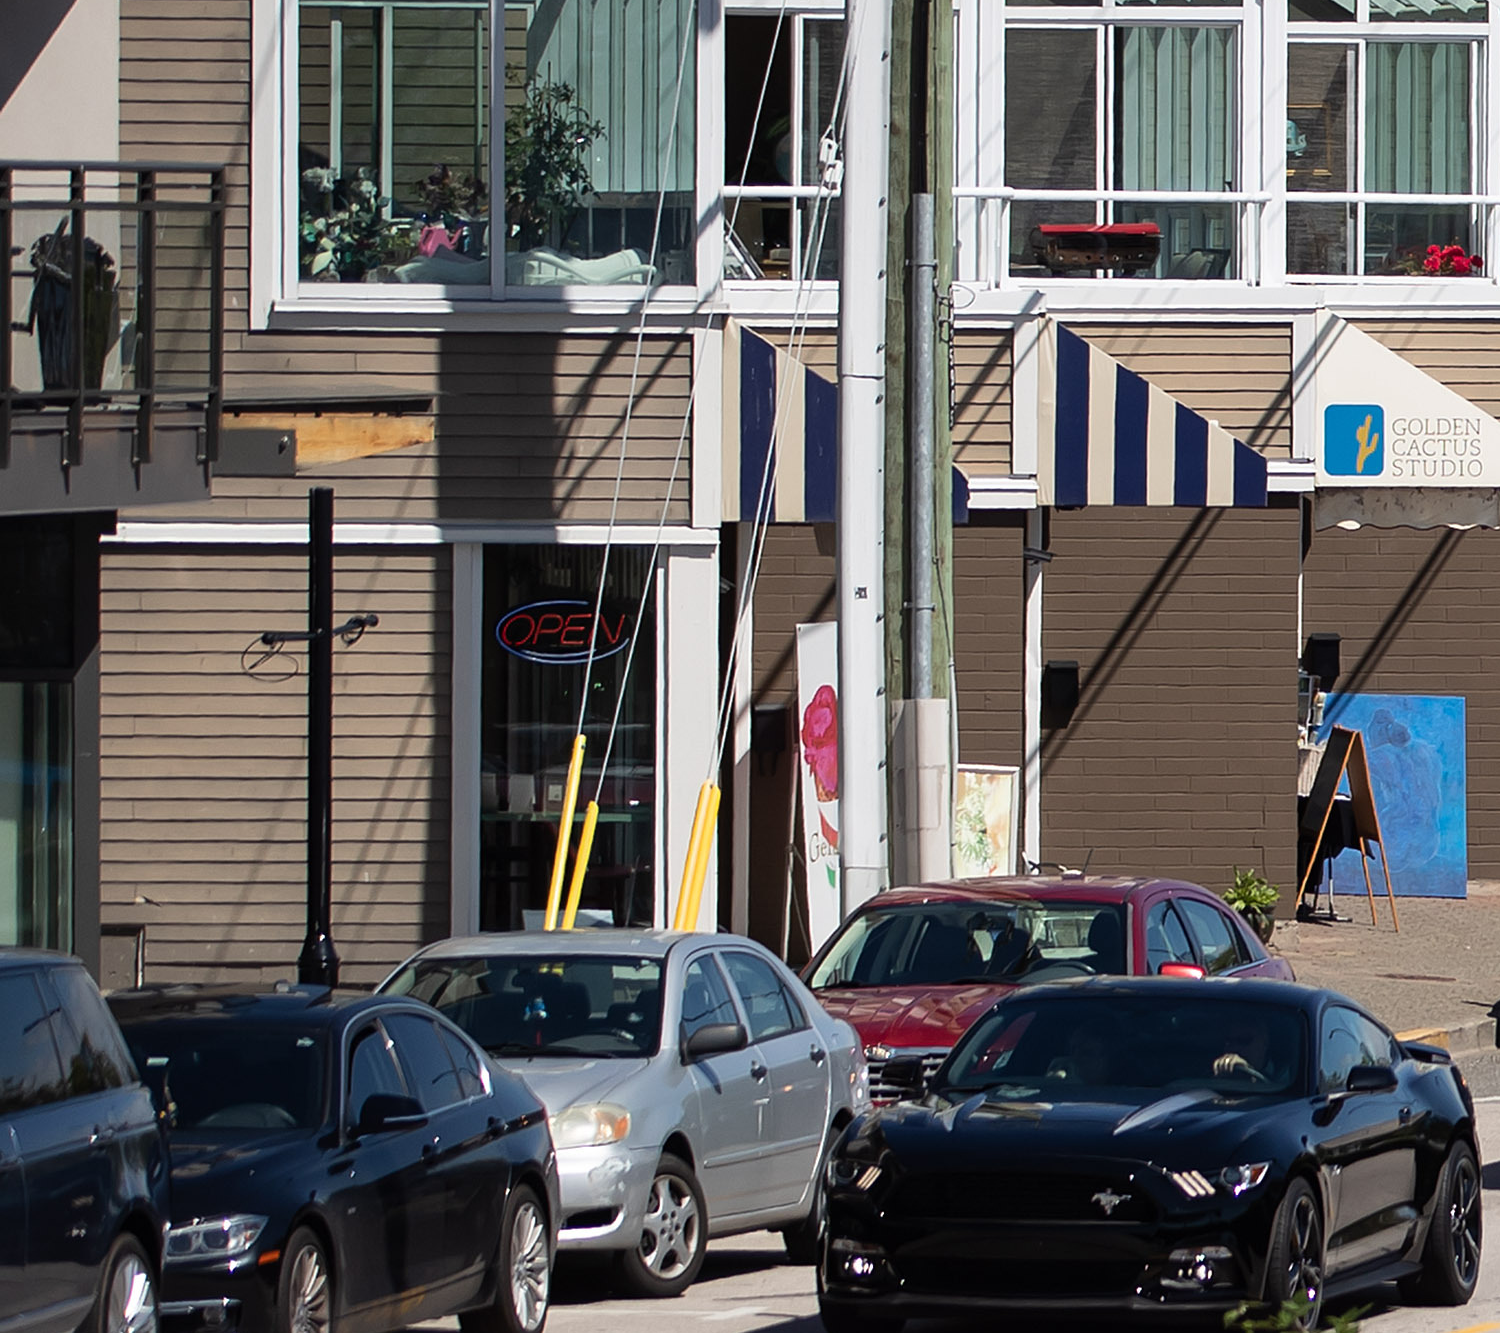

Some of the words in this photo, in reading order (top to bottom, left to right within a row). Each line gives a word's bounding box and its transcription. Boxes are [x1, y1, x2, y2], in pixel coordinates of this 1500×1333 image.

[1391, 418, 1481, 436] GOLDEN
[1391, 439, 1482, 457] CACTUS
[1391, 459, 1483, 478] STUDIO
[502, 613, 625, 646] OPEN
